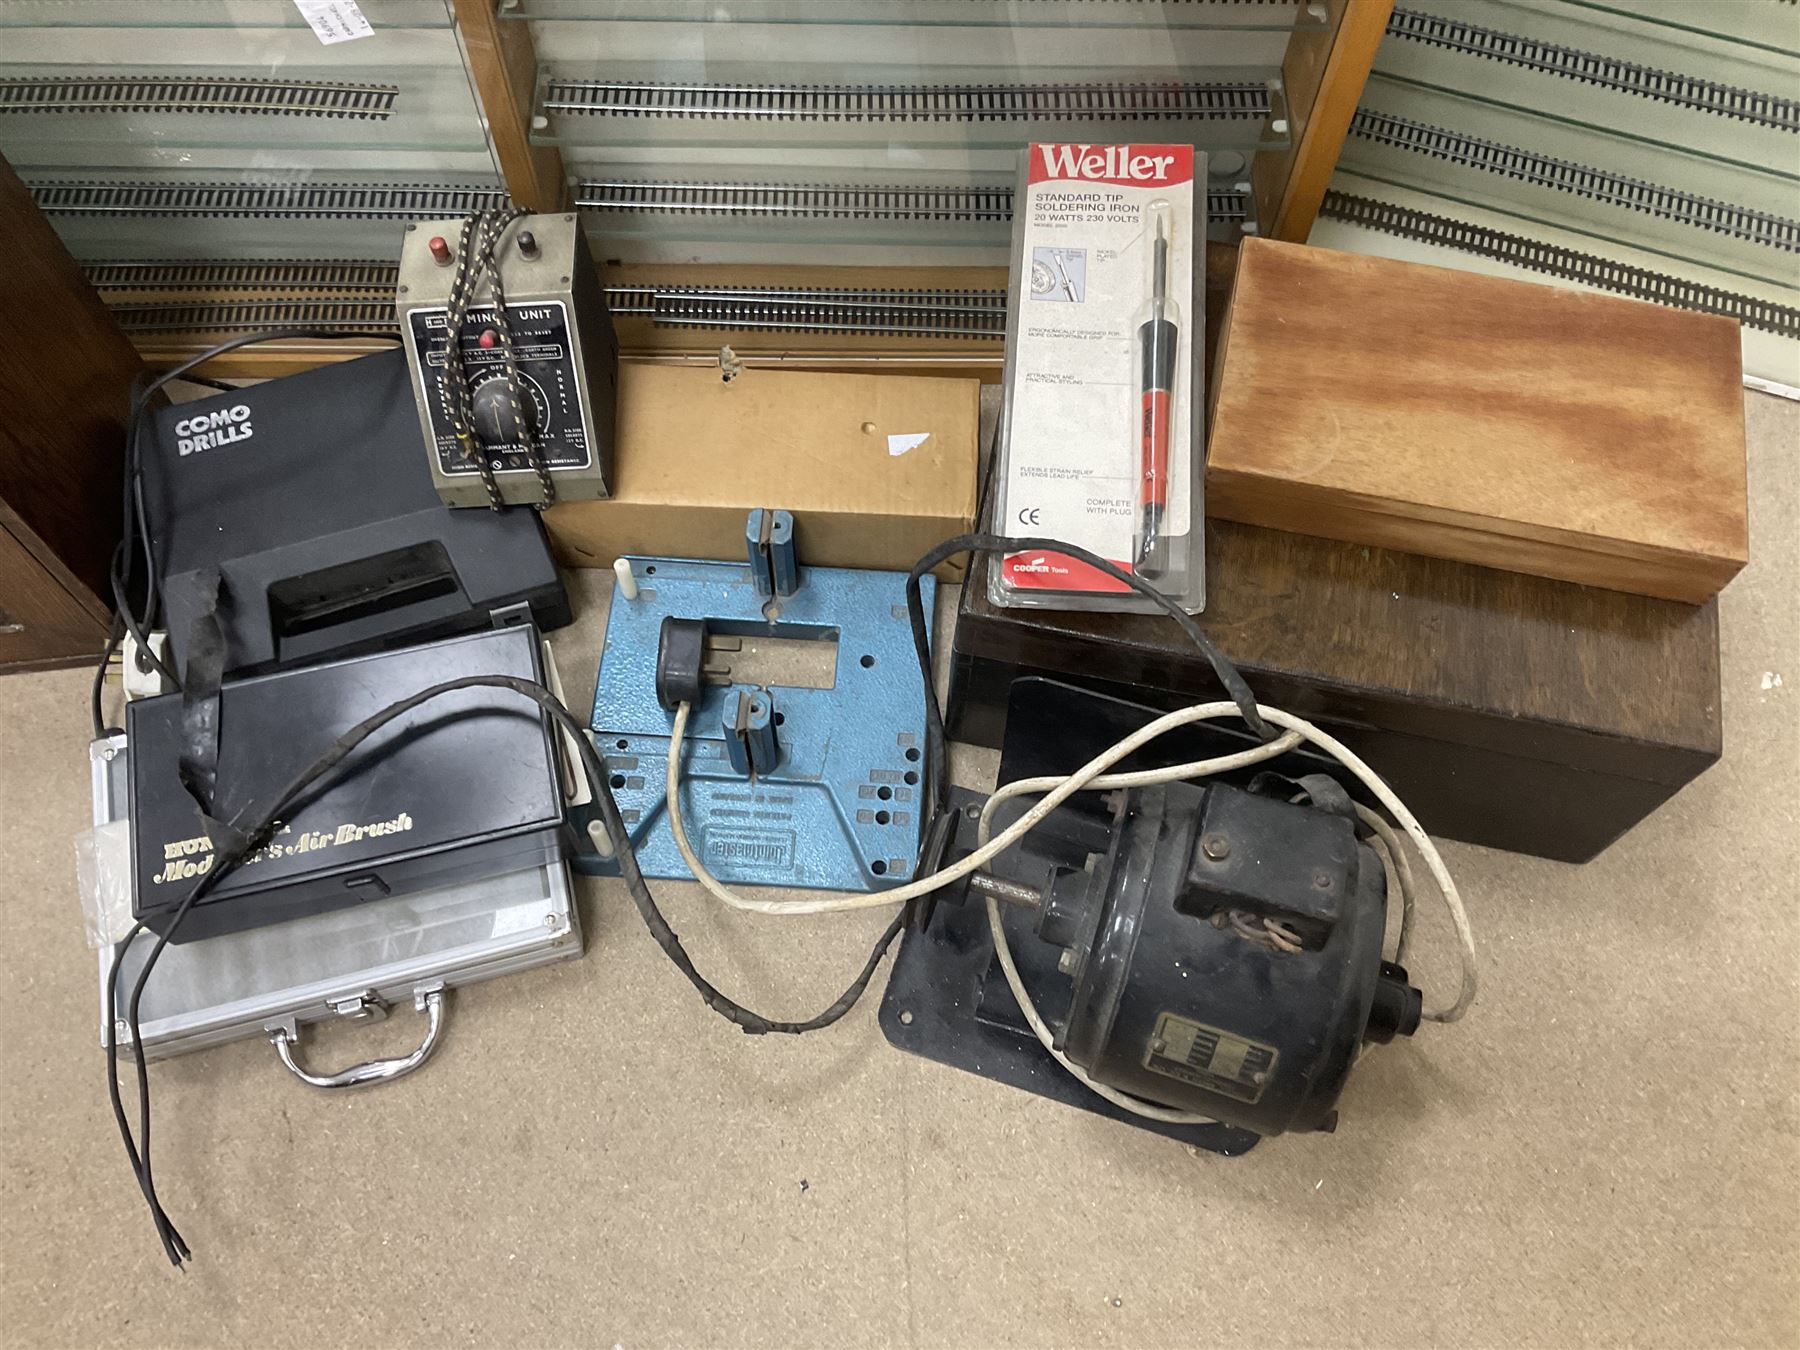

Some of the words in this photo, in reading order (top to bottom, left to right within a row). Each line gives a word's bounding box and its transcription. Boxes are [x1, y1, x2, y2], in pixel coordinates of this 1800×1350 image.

[1038, 144, 1175, 180] Weller
[1036, 193, 1101, 203] STANDARD
[1104, 193, 1124, 203] TIP
[1035, 202, 1106, 213] SOLDERING
[1109, 203, 1140, 213] IRON
[1034, 213, 1046, 222] 20
[1048, 213, 1084, 223] WATTS
[1086, 214, 1104, 223] 230
[1106, 214, 1139, 224] VOLTS
[519, 309, 552, 321] UNIT
[556, 369, 568, 414] NORMAL
[175, 404, 251, 437] COMO
[177, 421, 253, 457] DRILLS
[1086, 498, 1131, 507] COMPLETE
[1109, 508, 1132, 516] PLUG
[1013, 564, 1050, 573] COOPER
[1051, 566, 1069, 575] Tools
[286, 831, 334, 856] Air
[334, 812, 413, 846] Brush
